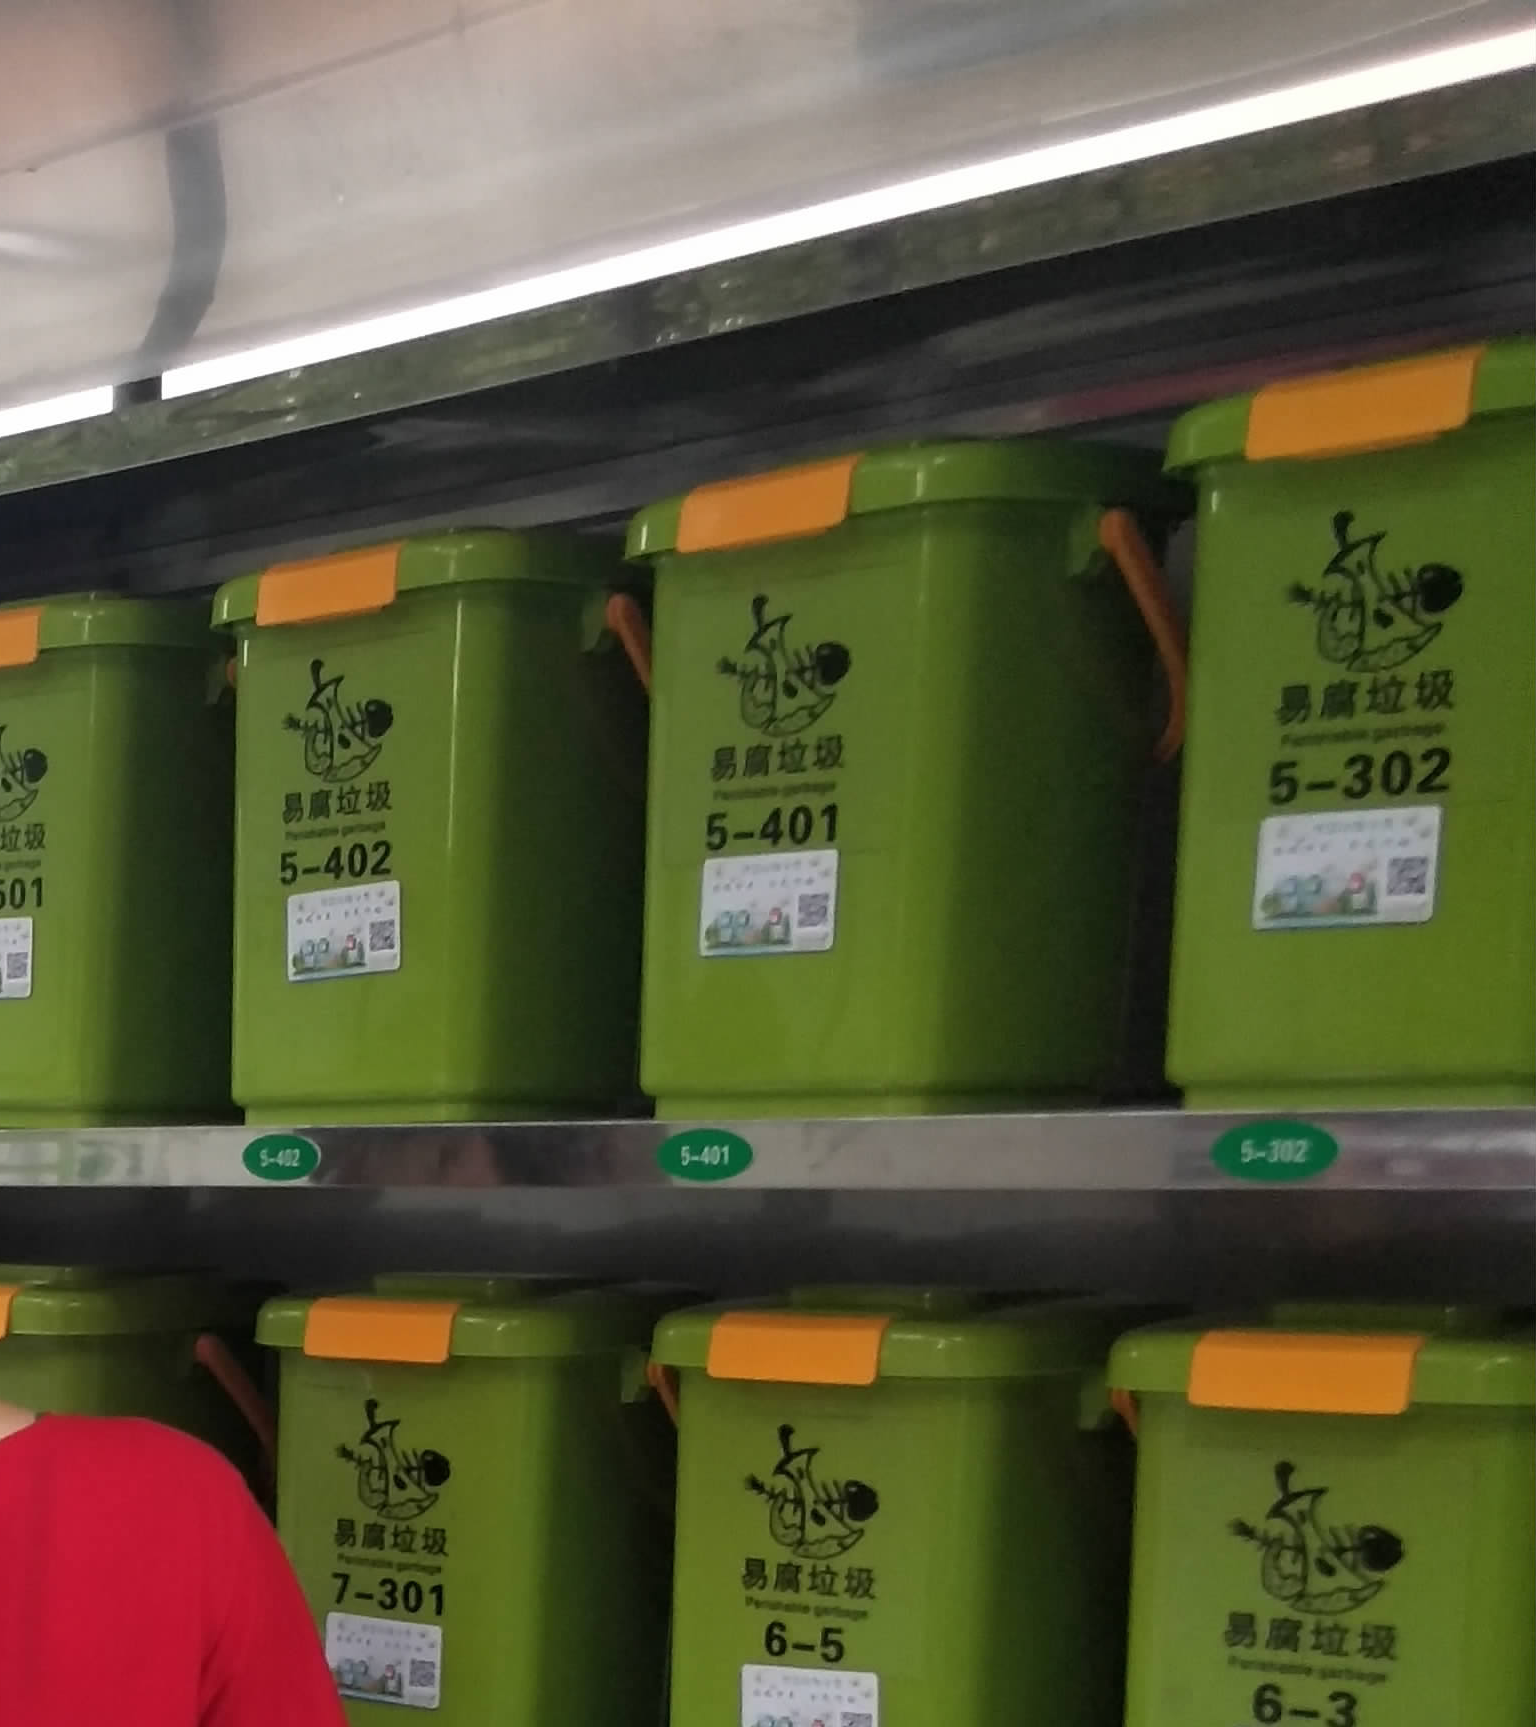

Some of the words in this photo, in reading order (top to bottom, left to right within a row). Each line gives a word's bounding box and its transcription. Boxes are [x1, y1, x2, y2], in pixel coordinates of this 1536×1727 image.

[1275, 671, 1455, 725] 易腐垃圾
[712, 735, 844, 782] 易腐垃圾
[1269, 748, 1451, 804] 5-302
[282, 781, 392, 824] 易腐垃圾
[706, 803, 838, 850] 5-401
[280, 840, 391, 885] 5-402
[260, 1147, 300, 1167] 5-402
[681, 1144, 730, 1165] 5-401
[1241, 1138, 1311, 1164] 5-302
[335, 1519, 448, 1556] 易腐垃圾
[332, 1572, 444, 1616] 7-301
[742, 1558, 876, 1599] 易腐垃圾
[765, 1620, 844, 1662] 6-5
[1225, 1612, 1398, 1660] 易腐垃圾
